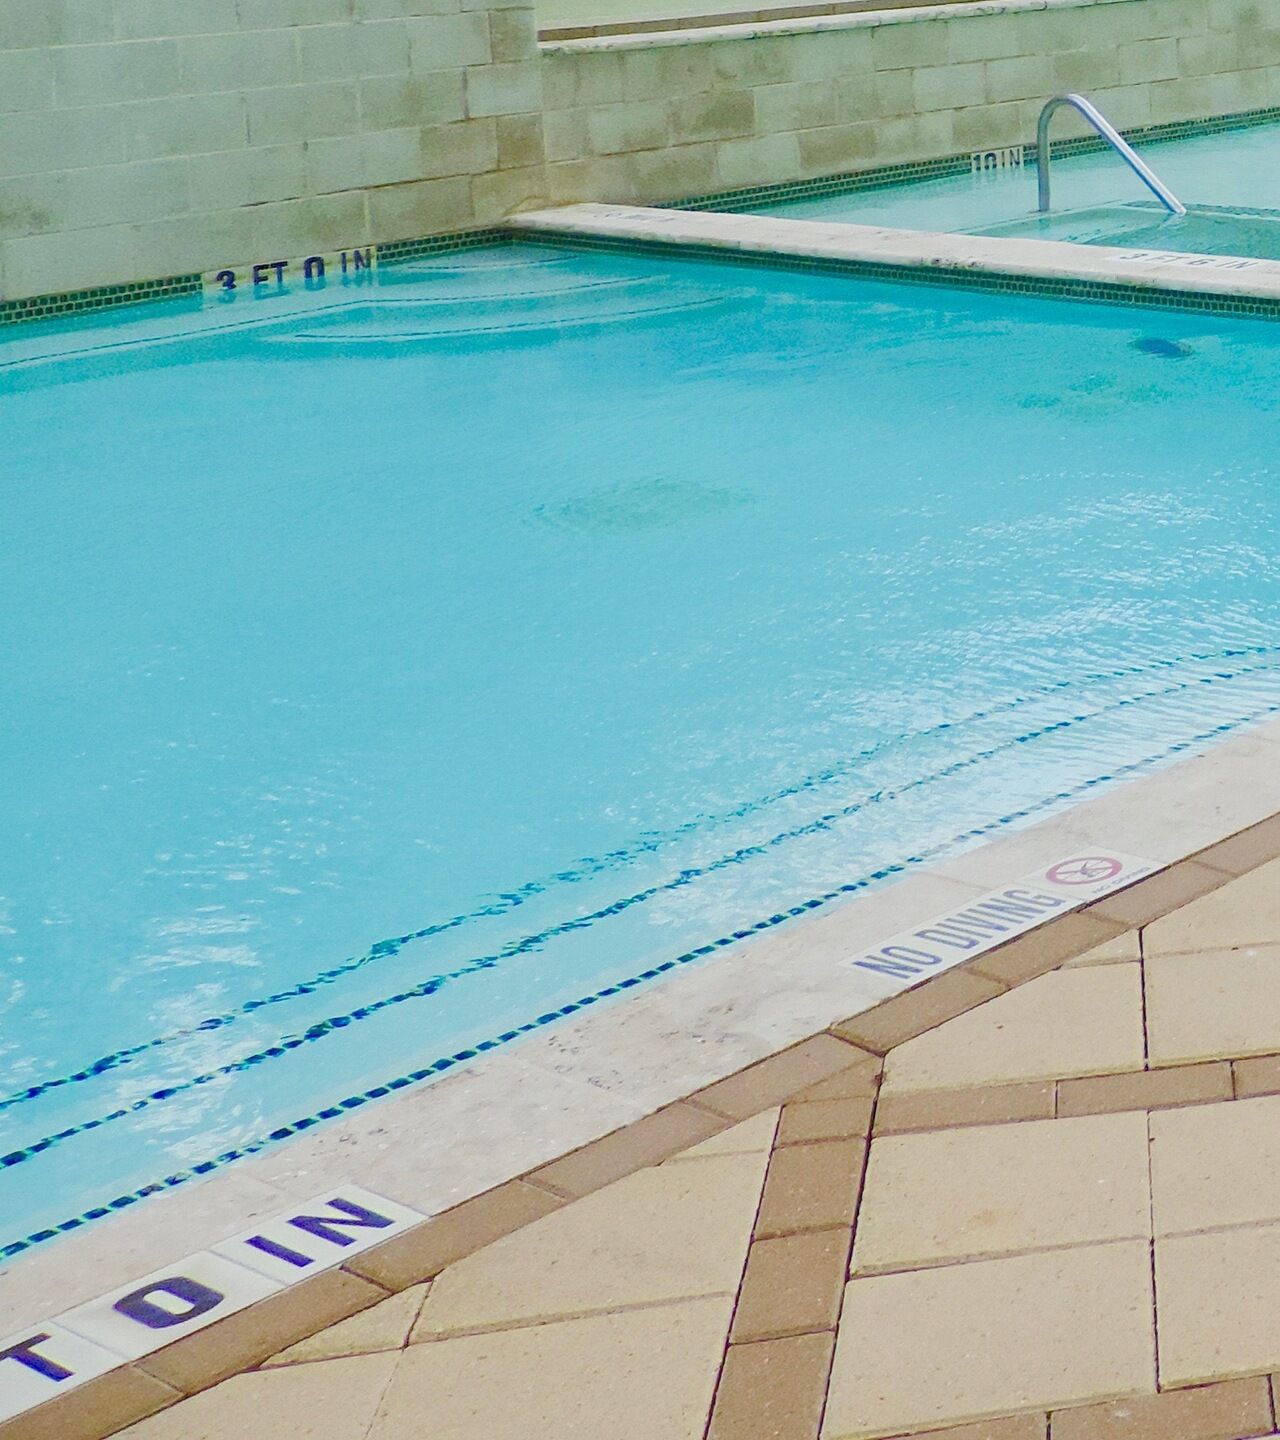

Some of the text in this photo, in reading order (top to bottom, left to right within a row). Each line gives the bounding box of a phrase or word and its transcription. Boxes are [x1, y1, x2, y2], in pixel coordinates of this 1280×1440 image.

[1001, 148, 1021, 168] IN
[341, 248, 371, 273] IN
[853, 889, 1067, 980] NO DIVING
[243, 1197, 396, 1268] IN
